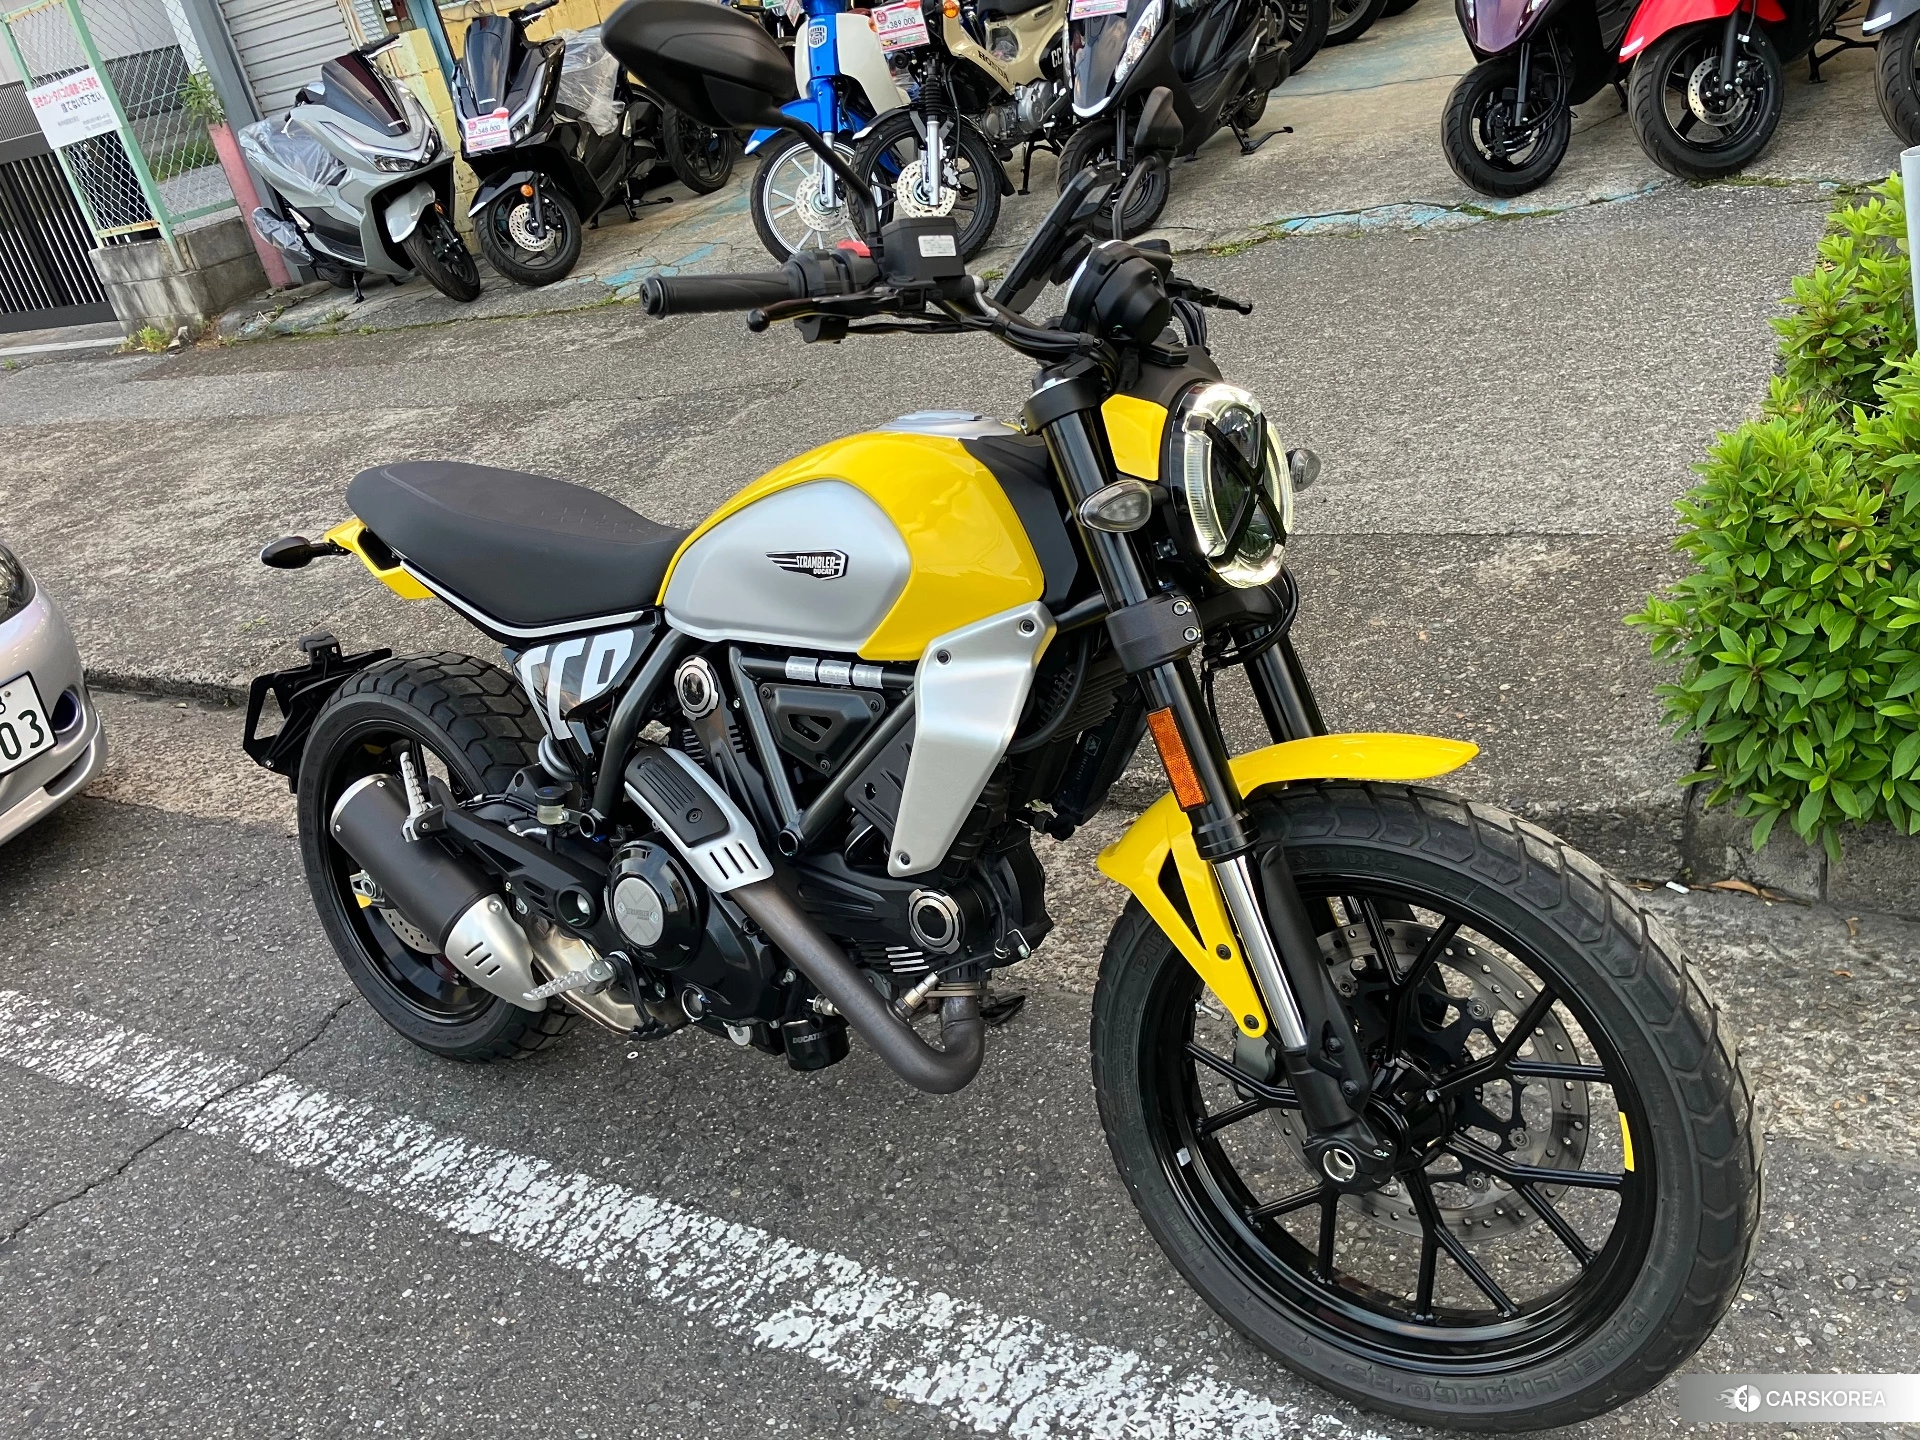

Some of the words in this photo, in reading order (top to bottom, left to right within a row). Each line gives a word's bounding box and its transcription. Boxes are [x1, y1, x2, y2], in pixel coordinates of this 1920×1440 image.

[977, 50, 1010, 84] HONDA
[796, 555, 836, 569] SCRAMBLER
[793, 1032, 821, 1043] DUCATI
[1520, 1306, 1650, 1402] PIRELLI
